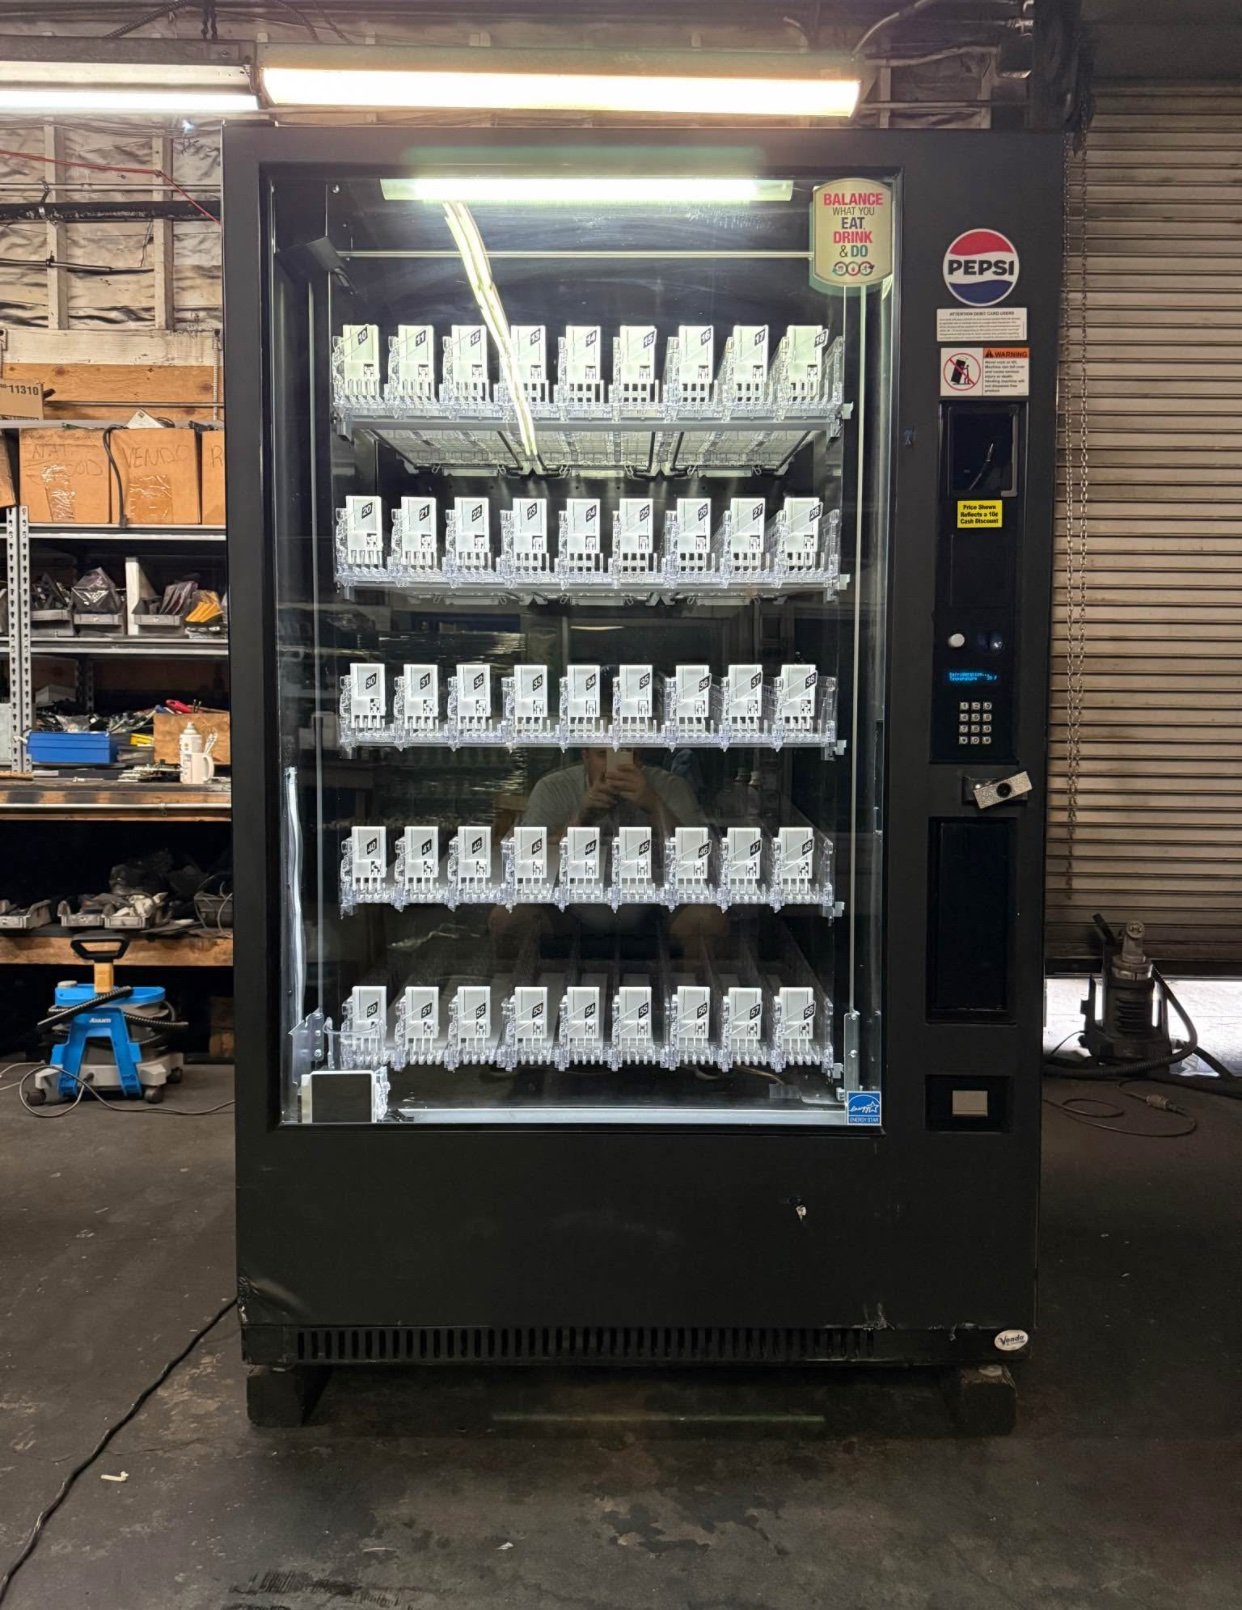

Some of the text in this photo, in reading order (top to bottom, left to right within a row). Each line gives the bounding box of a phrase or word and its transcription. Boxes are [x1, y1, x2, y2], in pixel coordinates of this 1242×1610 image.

[824, 192, 884, 206] BALANCE
[832, 206, 875, 216] WHAT YOU
[833, 231, 873, 244] DRINK
[839, 245, 868, 257] & DO
[948, 260, 1015, 276] PEPSI
[358, 330, 367, 343] 10
[416, 333, 426, 345] 11
[471, 332, 480, 345] 12
[530, 331, 540, 344] 13
[644, 332, 654, 345] 15
[701, 330, 710, 342] 16
[755, 330, 764, 342] 17
[816, 333, 826, 345] 18
[10, 384, 38, 396] 11310
[362, 505, 372, 517] 20
[420, 507, 429, 519] 21
[472, 508, 482, 520] 22
[586, 508, 596, 520] 24
[640, 507, 650, 520] 25
[698, 506, 707, 518] 26
[753, 506, 762, 518] 27
[366, 675, 376, 688] 30
[420, 675, 430, 688] 31
[474, 676, 484, 688] 32
[640, 675, 650, 688] 35
[700, 677, 709, 689] 36
[751, 675, 760, 687] 37
[367, 840, 376, 853] 40
[422, 841, 432, 854] 41
[472, 840, 482, 852] 42
[532, 841, 542, 853] 43
[586, 842, 595, 854] 44
[640, 842, 649, 854] 45
[750, 842, 760, 855] 47
[368, 1004, 377, 1017] 50
[422, 1005, 431, 1017] 51
[476, 1005, 486, 1018] 52
[532, 1005, 542, 1017] 53
[585, 1005, 594, 1017] 54
[638, 1004, 648, 1017] 55
[697, 1005, 706, 1017] 56
[750, 1006, 760, 1019] 57
[804, 1006, 814, 1019] 58
[998, 1334, 1024, 1346] Vendo
